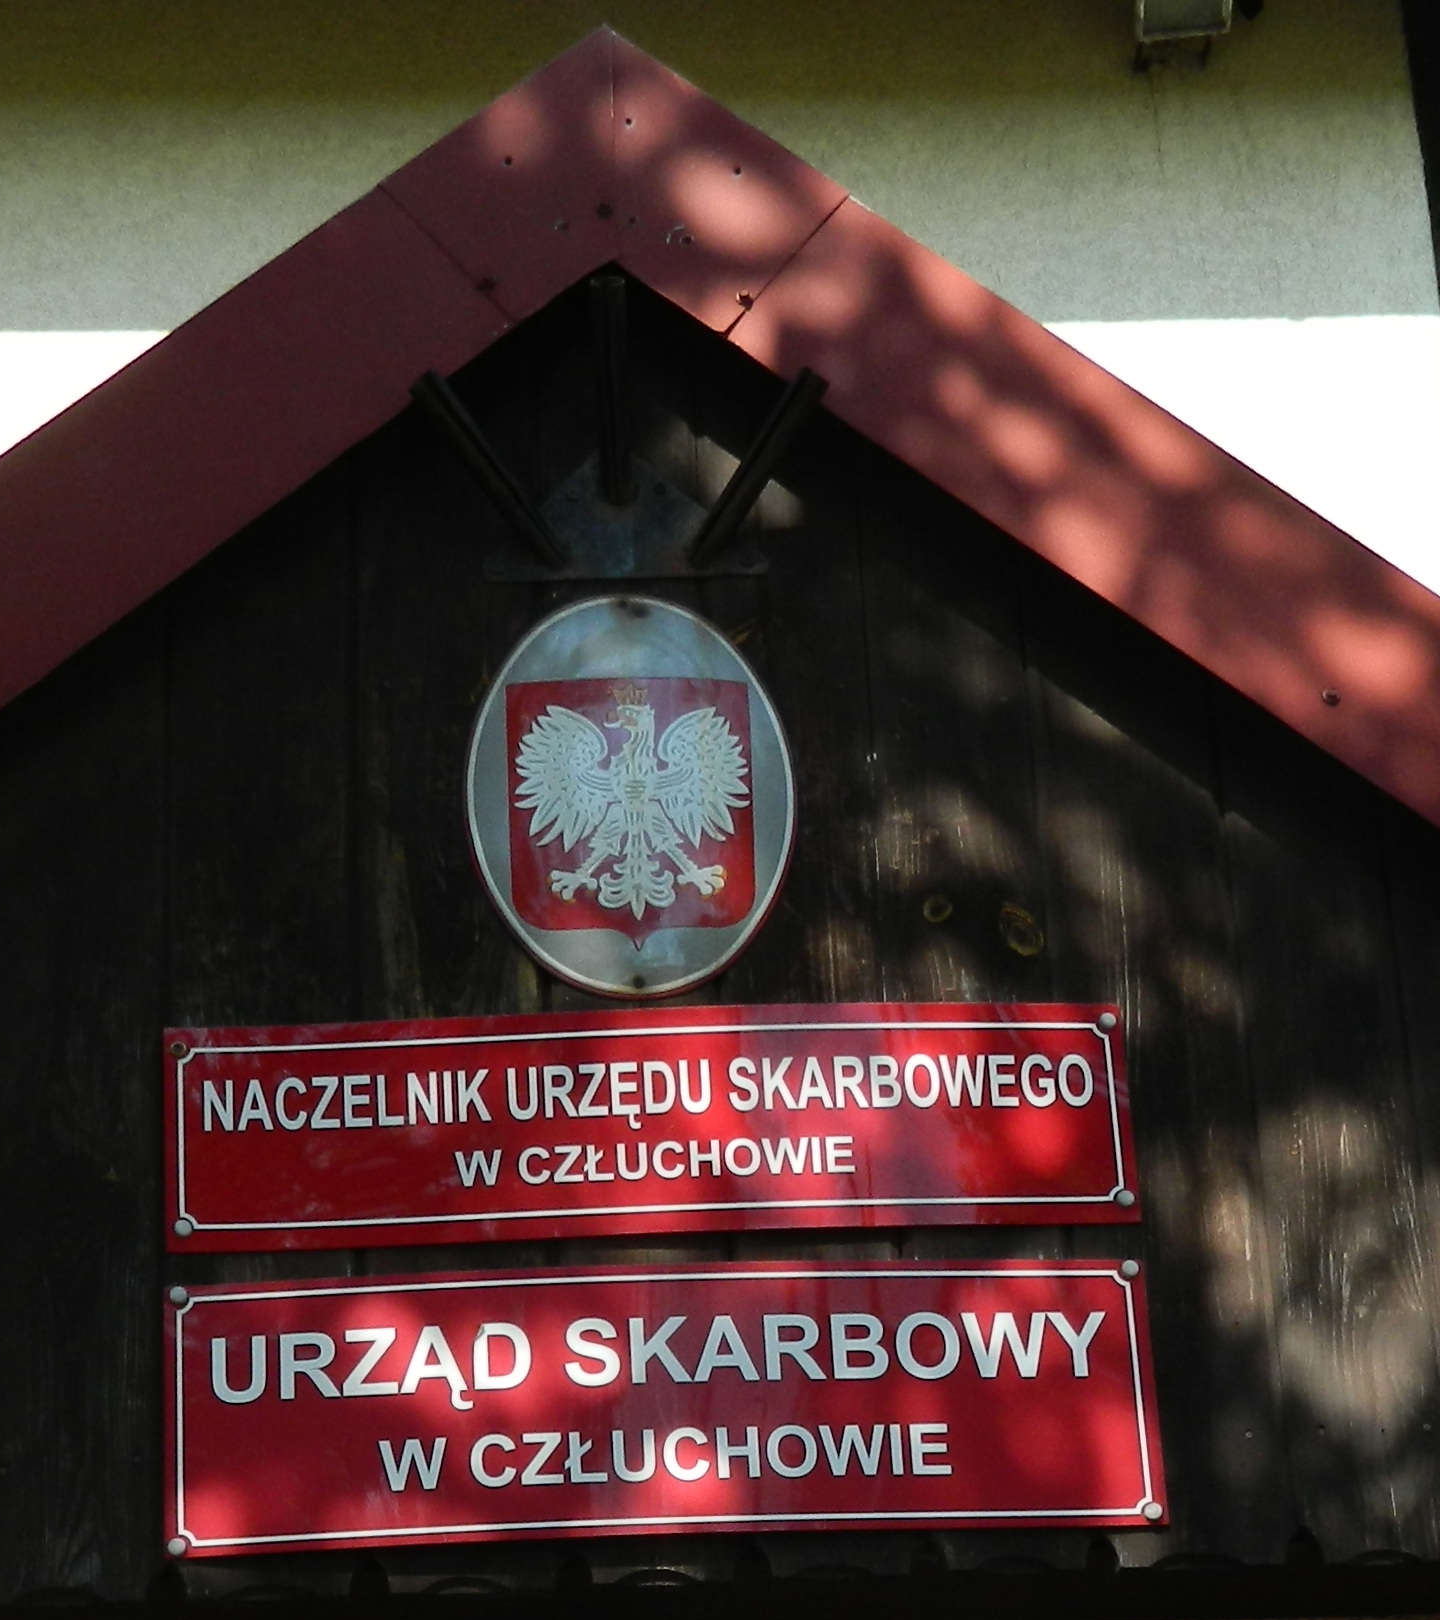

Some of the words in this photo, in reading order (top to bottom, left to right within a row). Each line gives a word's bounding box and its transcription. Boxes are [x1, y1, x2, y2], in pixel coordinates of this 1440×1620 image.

[202, 1066, 491, 1132] NACZELNIK
[507, 1058, 713, 1130] URZĘDU
[728, 1051, 1094, 1112] SKARBOWEGO
[455, 1150, 503, 1188] W
[517, 1136, 855, 1186] CZŁUCHOWIE
[210, 1322, 532, 1409] URZĄD
[564, 1312, 1105, 1388] SKARBOWY
[378, 1439, 446, 1492] W
[469, 1423, 952, 1487] CZŁUCHOWIE
